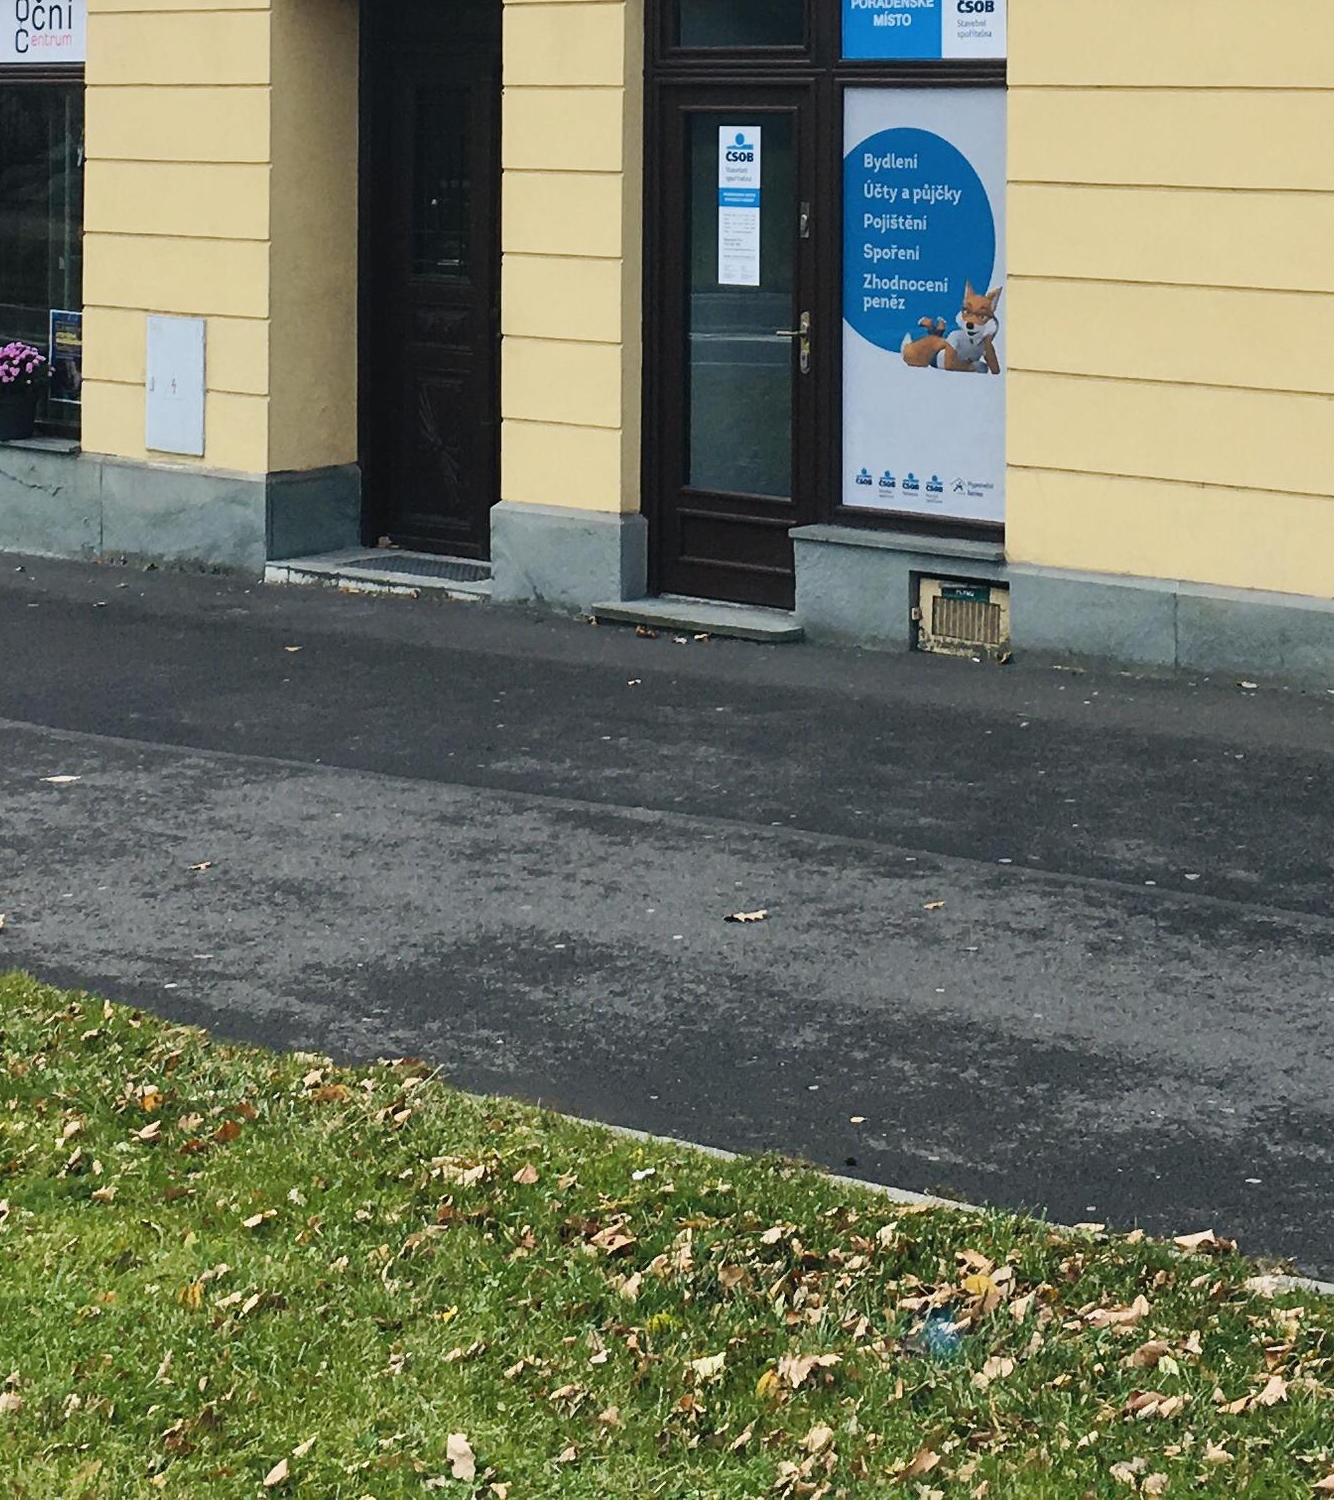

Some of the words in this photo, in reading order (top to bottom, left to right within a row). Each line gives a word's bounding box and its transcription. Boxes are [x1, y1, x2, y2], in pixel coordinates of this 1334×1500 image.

[957, 0, 995, 13] ČSOB
[873, 11, 912, 27] MÍSTO
[15, 29, 73, 53] Centrum
[863, 153, 918, 173] Bydlení
[863, 180, 898, 203] Účty
[901, 189, 910, 199] a
[913, 184, 962, 206] půjčky
[863, 213, 927, 234] Pojištění
[863, 243, 920, 264] Spoření
[863, 273, 949, 293] Zhodnocení
[863, 294, 906, 312] peněz
